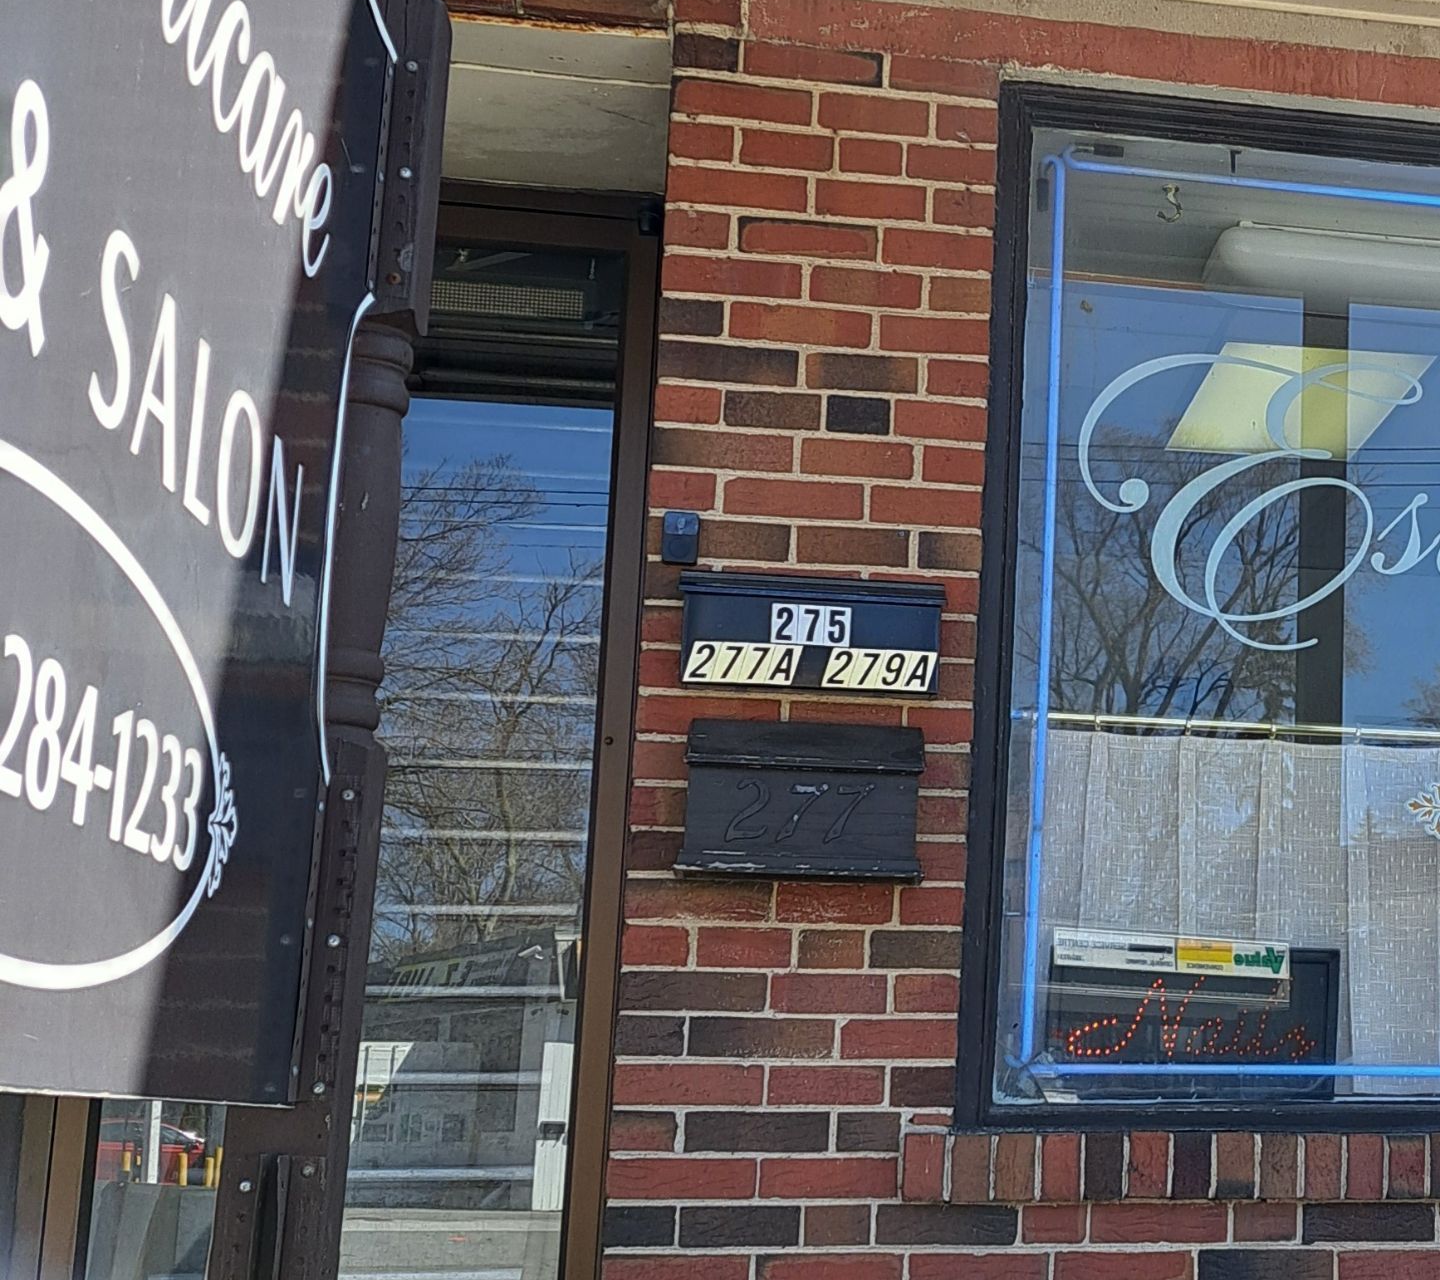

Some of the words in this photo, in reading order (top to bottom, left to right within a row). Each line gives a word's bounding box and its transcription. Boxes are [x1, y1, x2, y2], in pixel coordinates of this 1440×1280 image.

[88, 228, 305, 608] SALON
[775, 606, 847, 643] 275
[688, 643, 795, 681] 277A
[826, 650, 931, 688] 279A
[0, 634, 202, 872] 284-1233
[724, 778, 874, 843] 277
